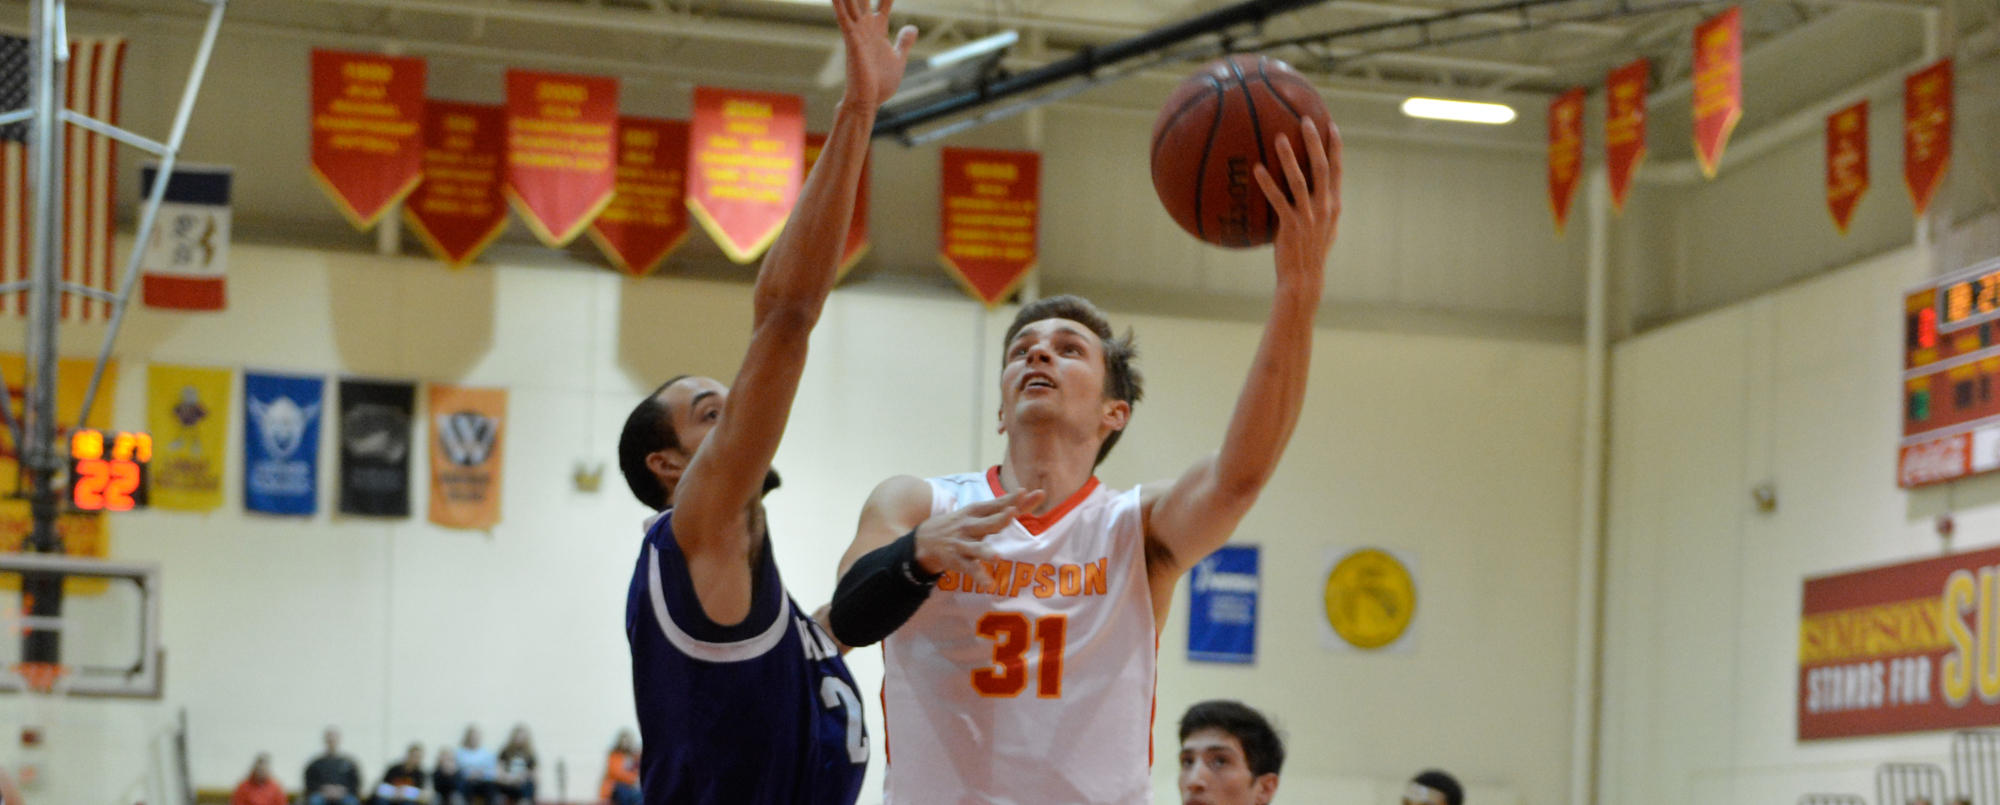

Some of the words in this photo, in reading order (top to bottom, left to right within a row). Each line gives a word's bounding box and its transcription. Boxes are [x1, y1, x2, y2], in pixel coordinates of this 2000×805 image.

[74, 458, 140, 511] 22
[971, 611, 1067, 698] 31
[1806, 659, 1885, 715] STANDS
[1887, 655, 1932, 707] FOR
[820, 675, 870, 764] 2
